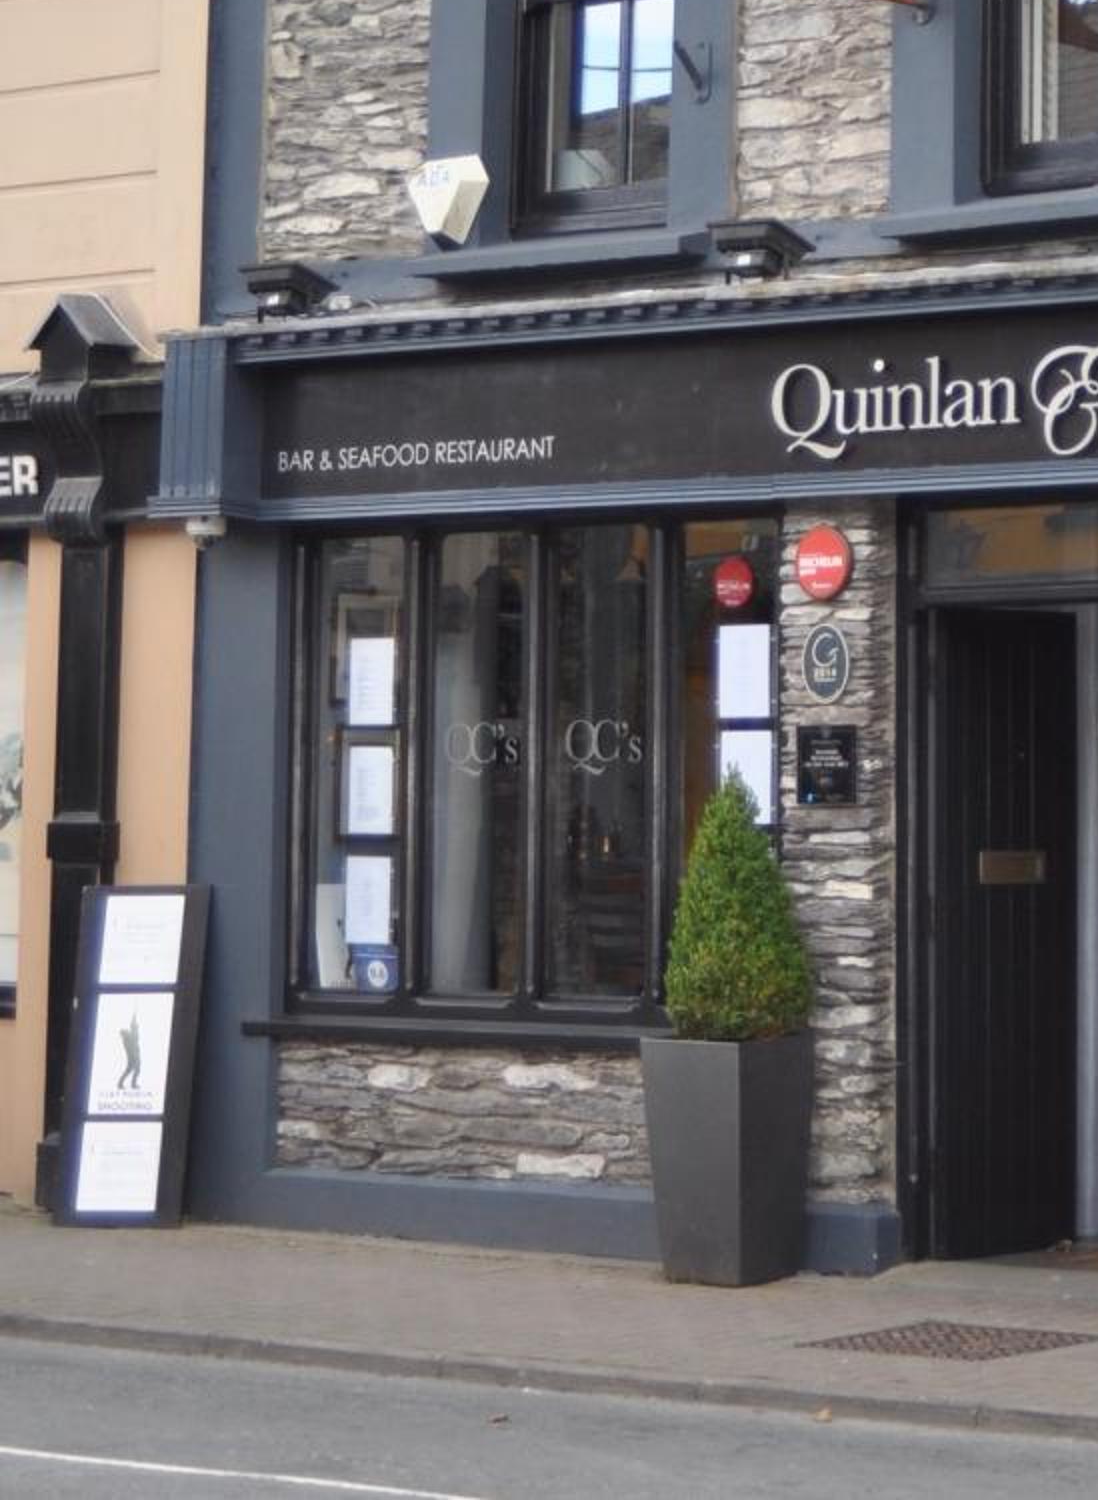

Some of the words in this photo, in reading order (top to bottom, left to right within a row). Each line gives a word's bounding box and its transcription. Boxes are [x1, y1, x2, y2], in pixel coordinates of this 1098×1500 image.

[771, 356, 1020, 459] Quinlan
[278, 450, 313, 473] BAR
[320, 451, 333, 471] &
[338, 443, 429, 470] SEAFOOD
[435, 435, 555, 464] RESTAURANT
[446, 722, 518, 777] QC's
[564, 718, 642, 775] QC's
